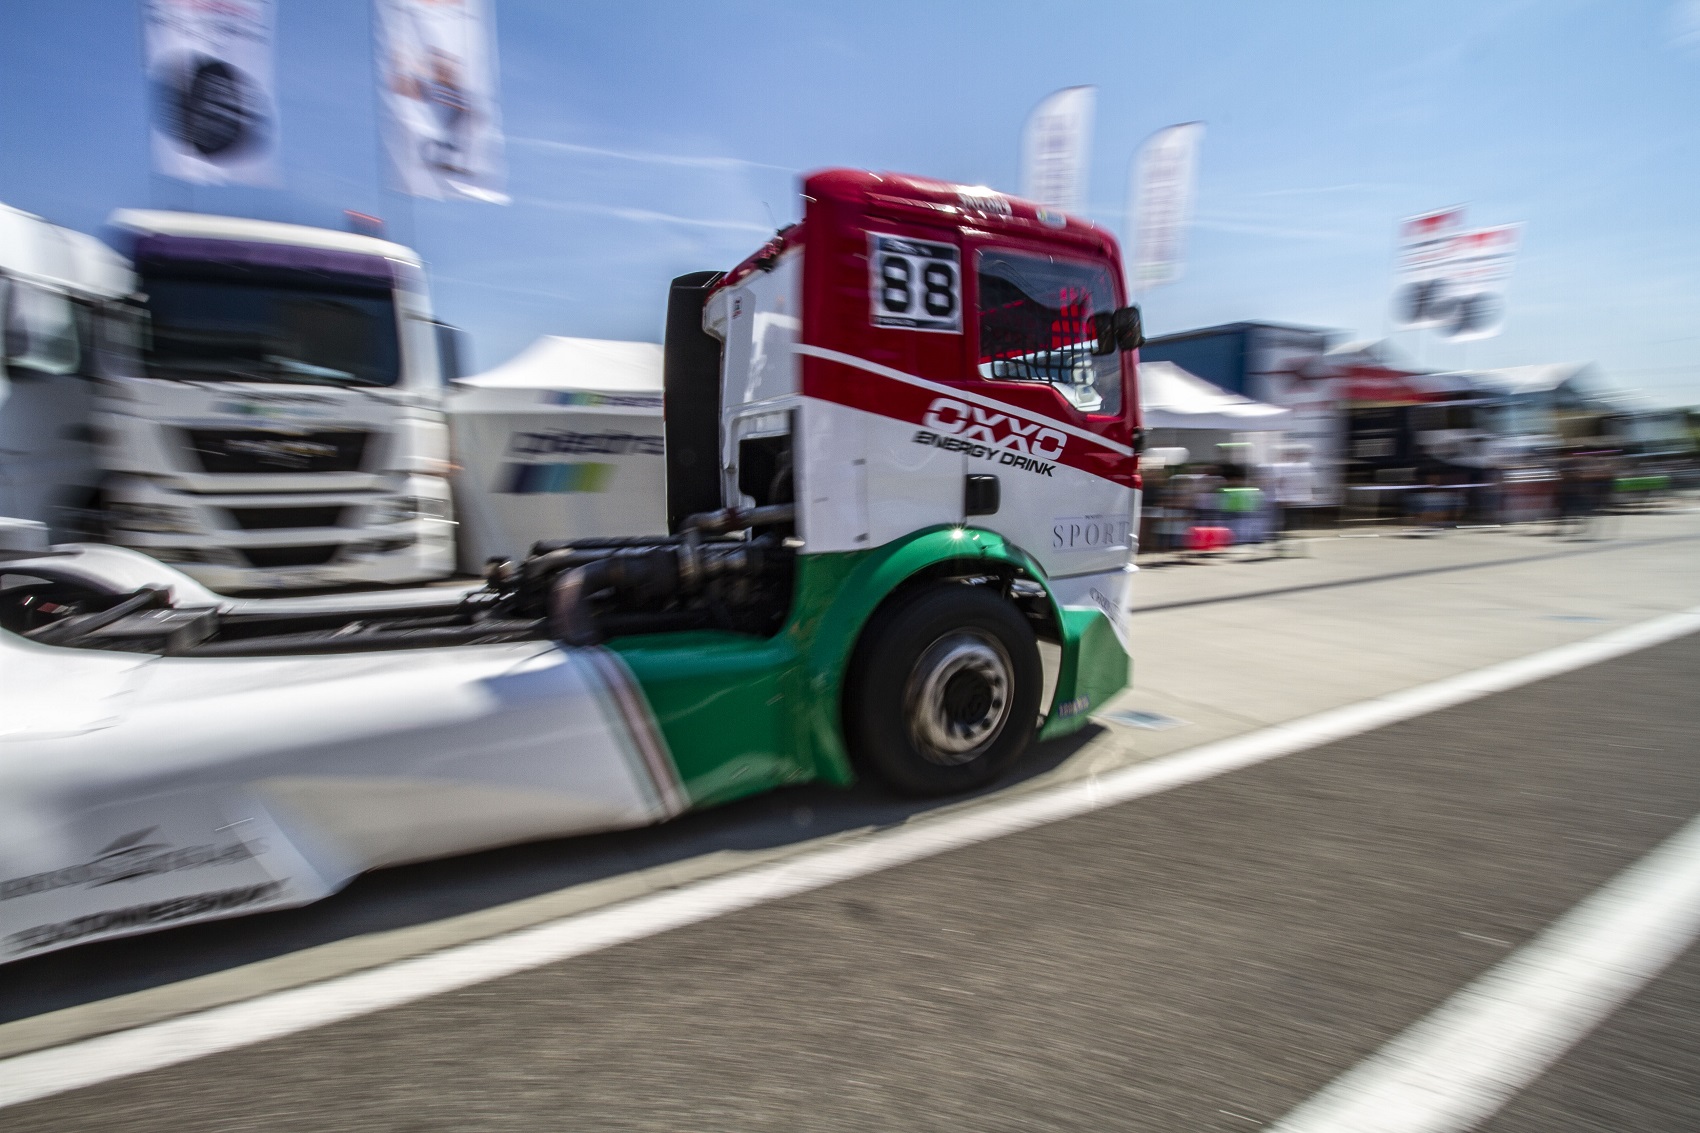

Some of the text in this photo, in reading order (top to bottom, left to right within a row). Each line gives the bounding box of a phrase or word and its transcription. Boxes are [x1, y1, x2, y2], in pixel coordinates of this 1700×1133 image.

[882, 256, 955, 316] 88
[912, 430, 1057, 477] ENERGY DRINK
[922, 397, 1068, 461] OXXO
[1053, 521, 1130, 548] SPORT
